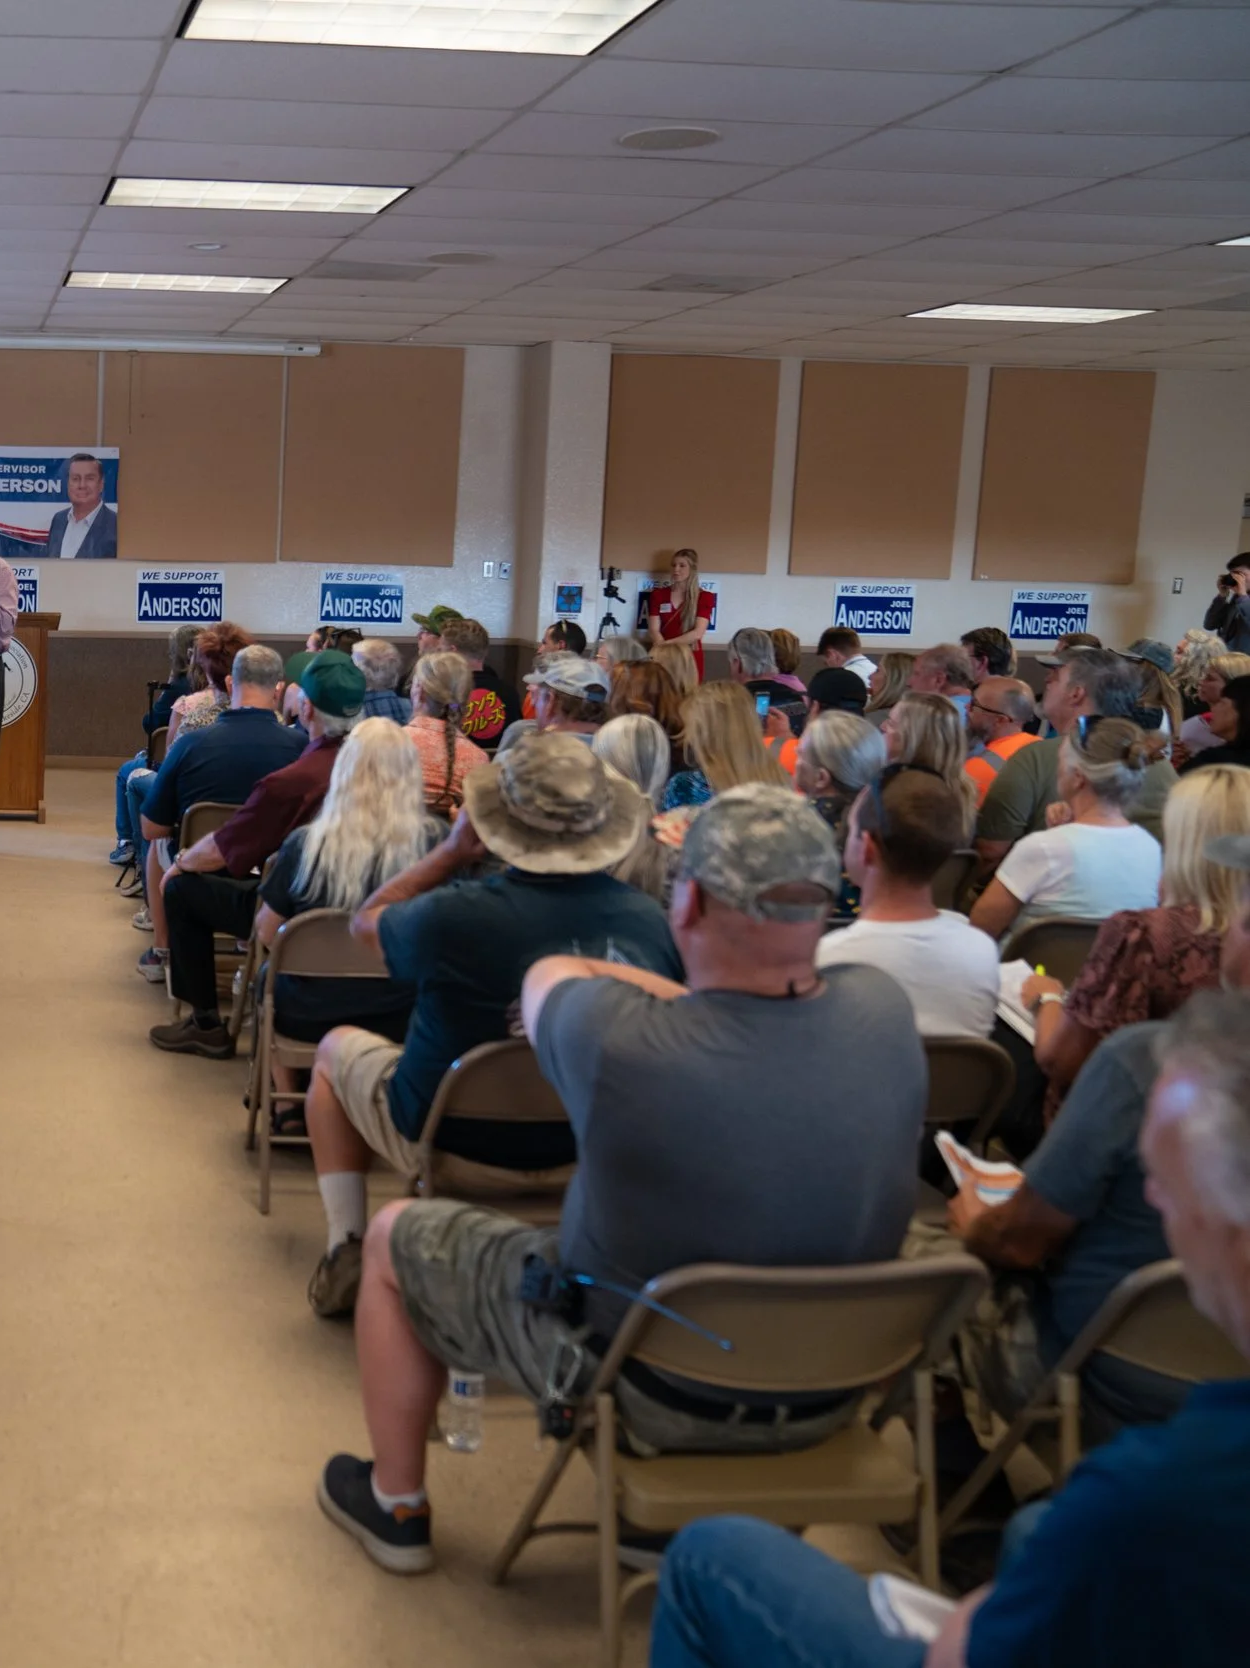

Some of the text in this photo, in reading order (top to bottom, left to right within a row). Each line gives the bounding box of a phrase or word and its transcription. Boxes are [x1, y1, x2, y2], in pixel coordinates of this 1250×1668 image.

[142, 571, 220, 581] WE SUPPORT
[325, 572, 344, 580] WE
[197, 586, 221, 595] JOEL
[378, 588, 402, 596] JOEL
[841, 585, 912, 595] WE SUPPORT
[1017, 591, 1088, 601] WE SUPPORT
[139, 590, 221, 617] ANDERSON
[321, 591, 402, 618] ANDERSON
[890, 600, 912, 608] JOEL
[1065, 607, 1087, 615] JOEL
[836, 603, 911, 630] ANDERSON
[1011, 609, 1086, 635] ANDERSON
